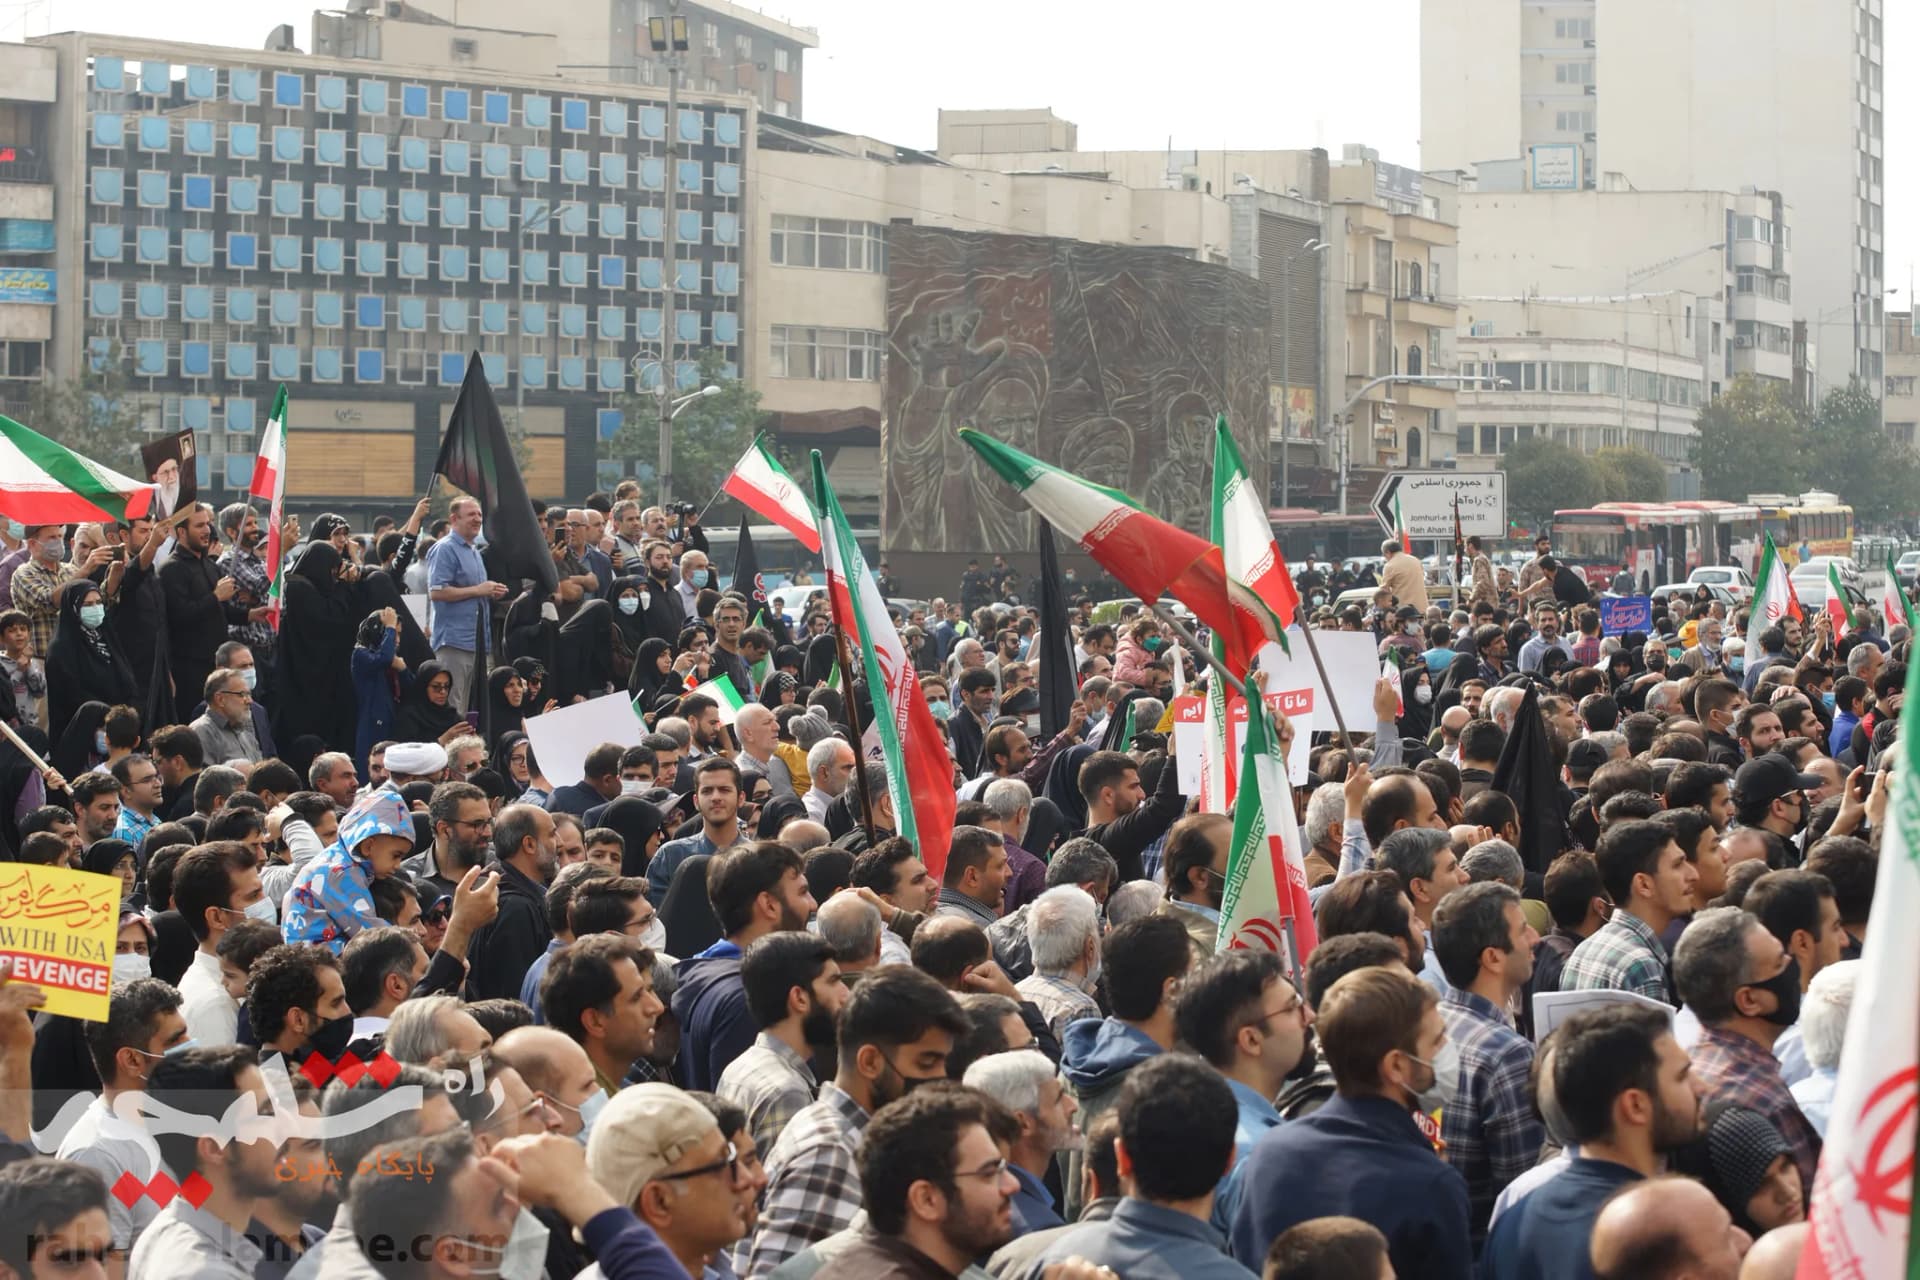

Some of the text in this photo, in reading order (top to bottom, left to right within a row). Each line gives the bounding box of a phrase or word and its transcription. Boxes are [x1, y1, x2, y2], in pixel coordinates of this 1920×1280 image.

[1410, 477, 1482, 490] جمهوری اسلامی
[1409, 513, 1448, 522] Jomhuri-e
[1449, 513, 1475, 521] Eami
[1409, 526, 1425, 534] Rah
[1426, 526, 1447, 534] Ahan
[0, 926, 108, 962] WITH USA
